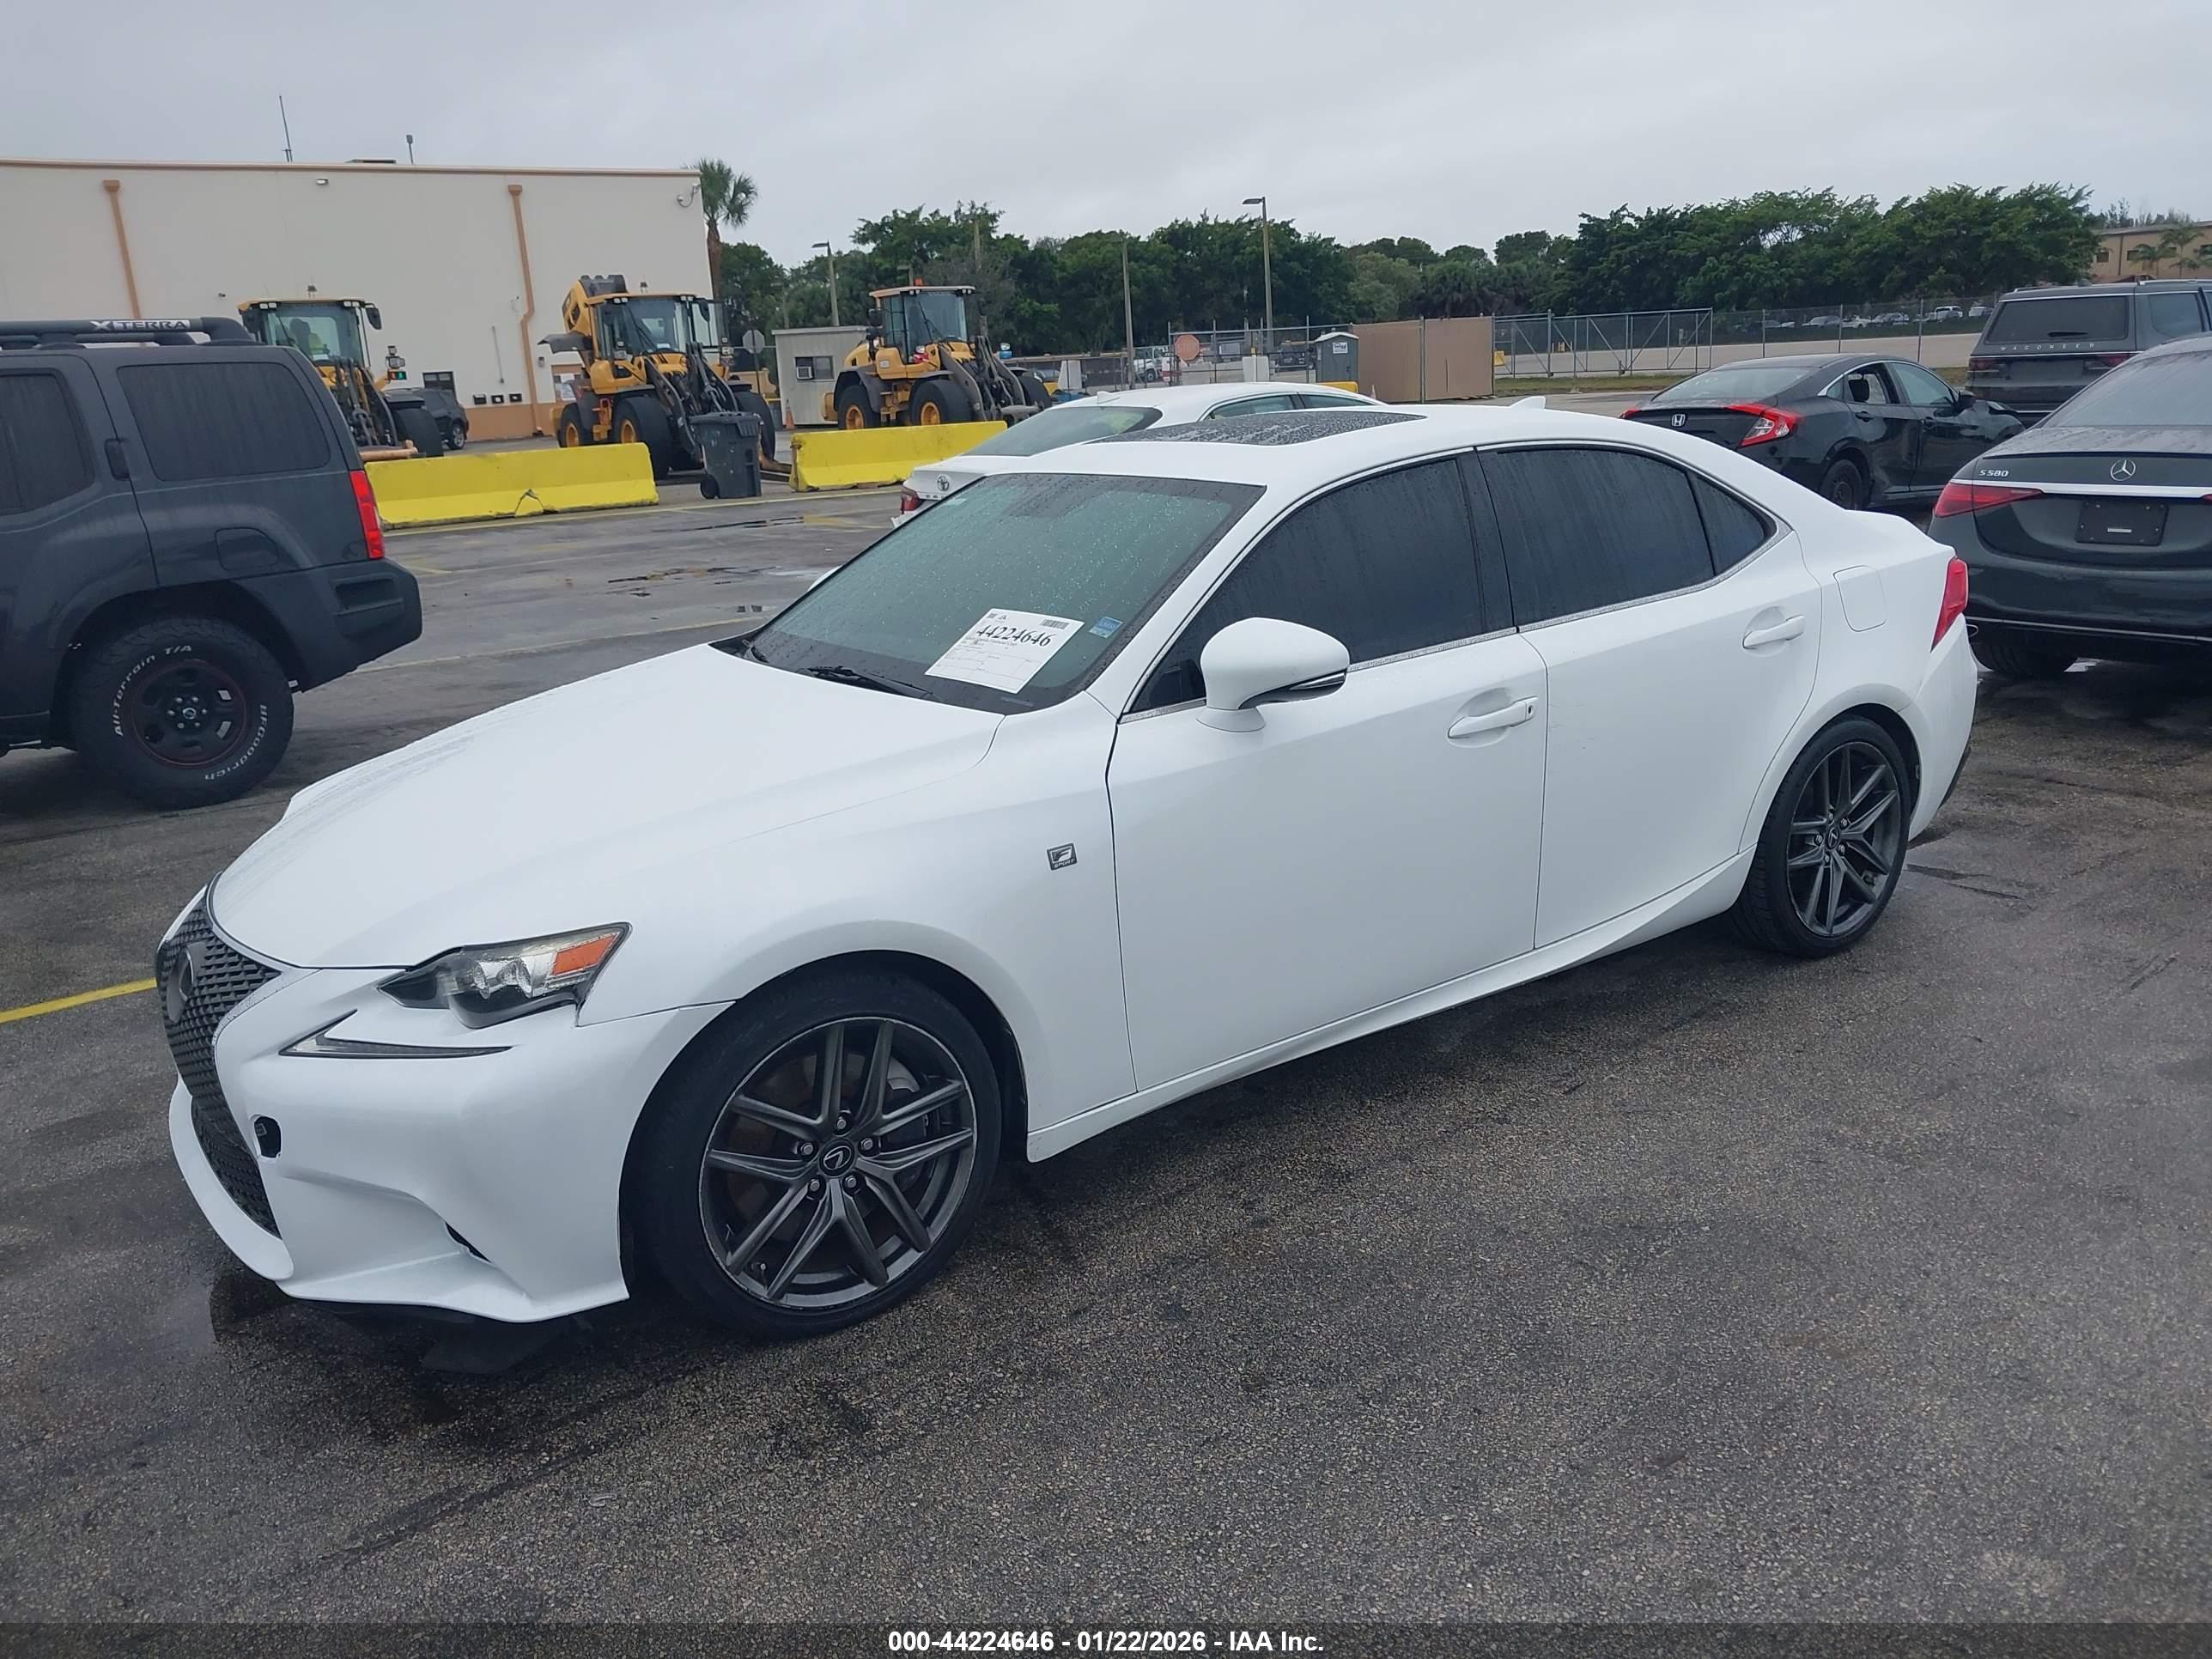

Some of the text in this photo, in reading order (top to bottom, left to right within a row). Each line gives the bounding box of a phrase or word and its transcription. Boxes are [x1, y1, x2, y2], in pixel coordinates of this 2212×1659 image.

[89, 320, 190, 331] XTERRA
[2000, 343, 2095, 352] WAGONEER
[976, 624, 1058, 647] 44224646
[164, 645, 192, 654] T/A
